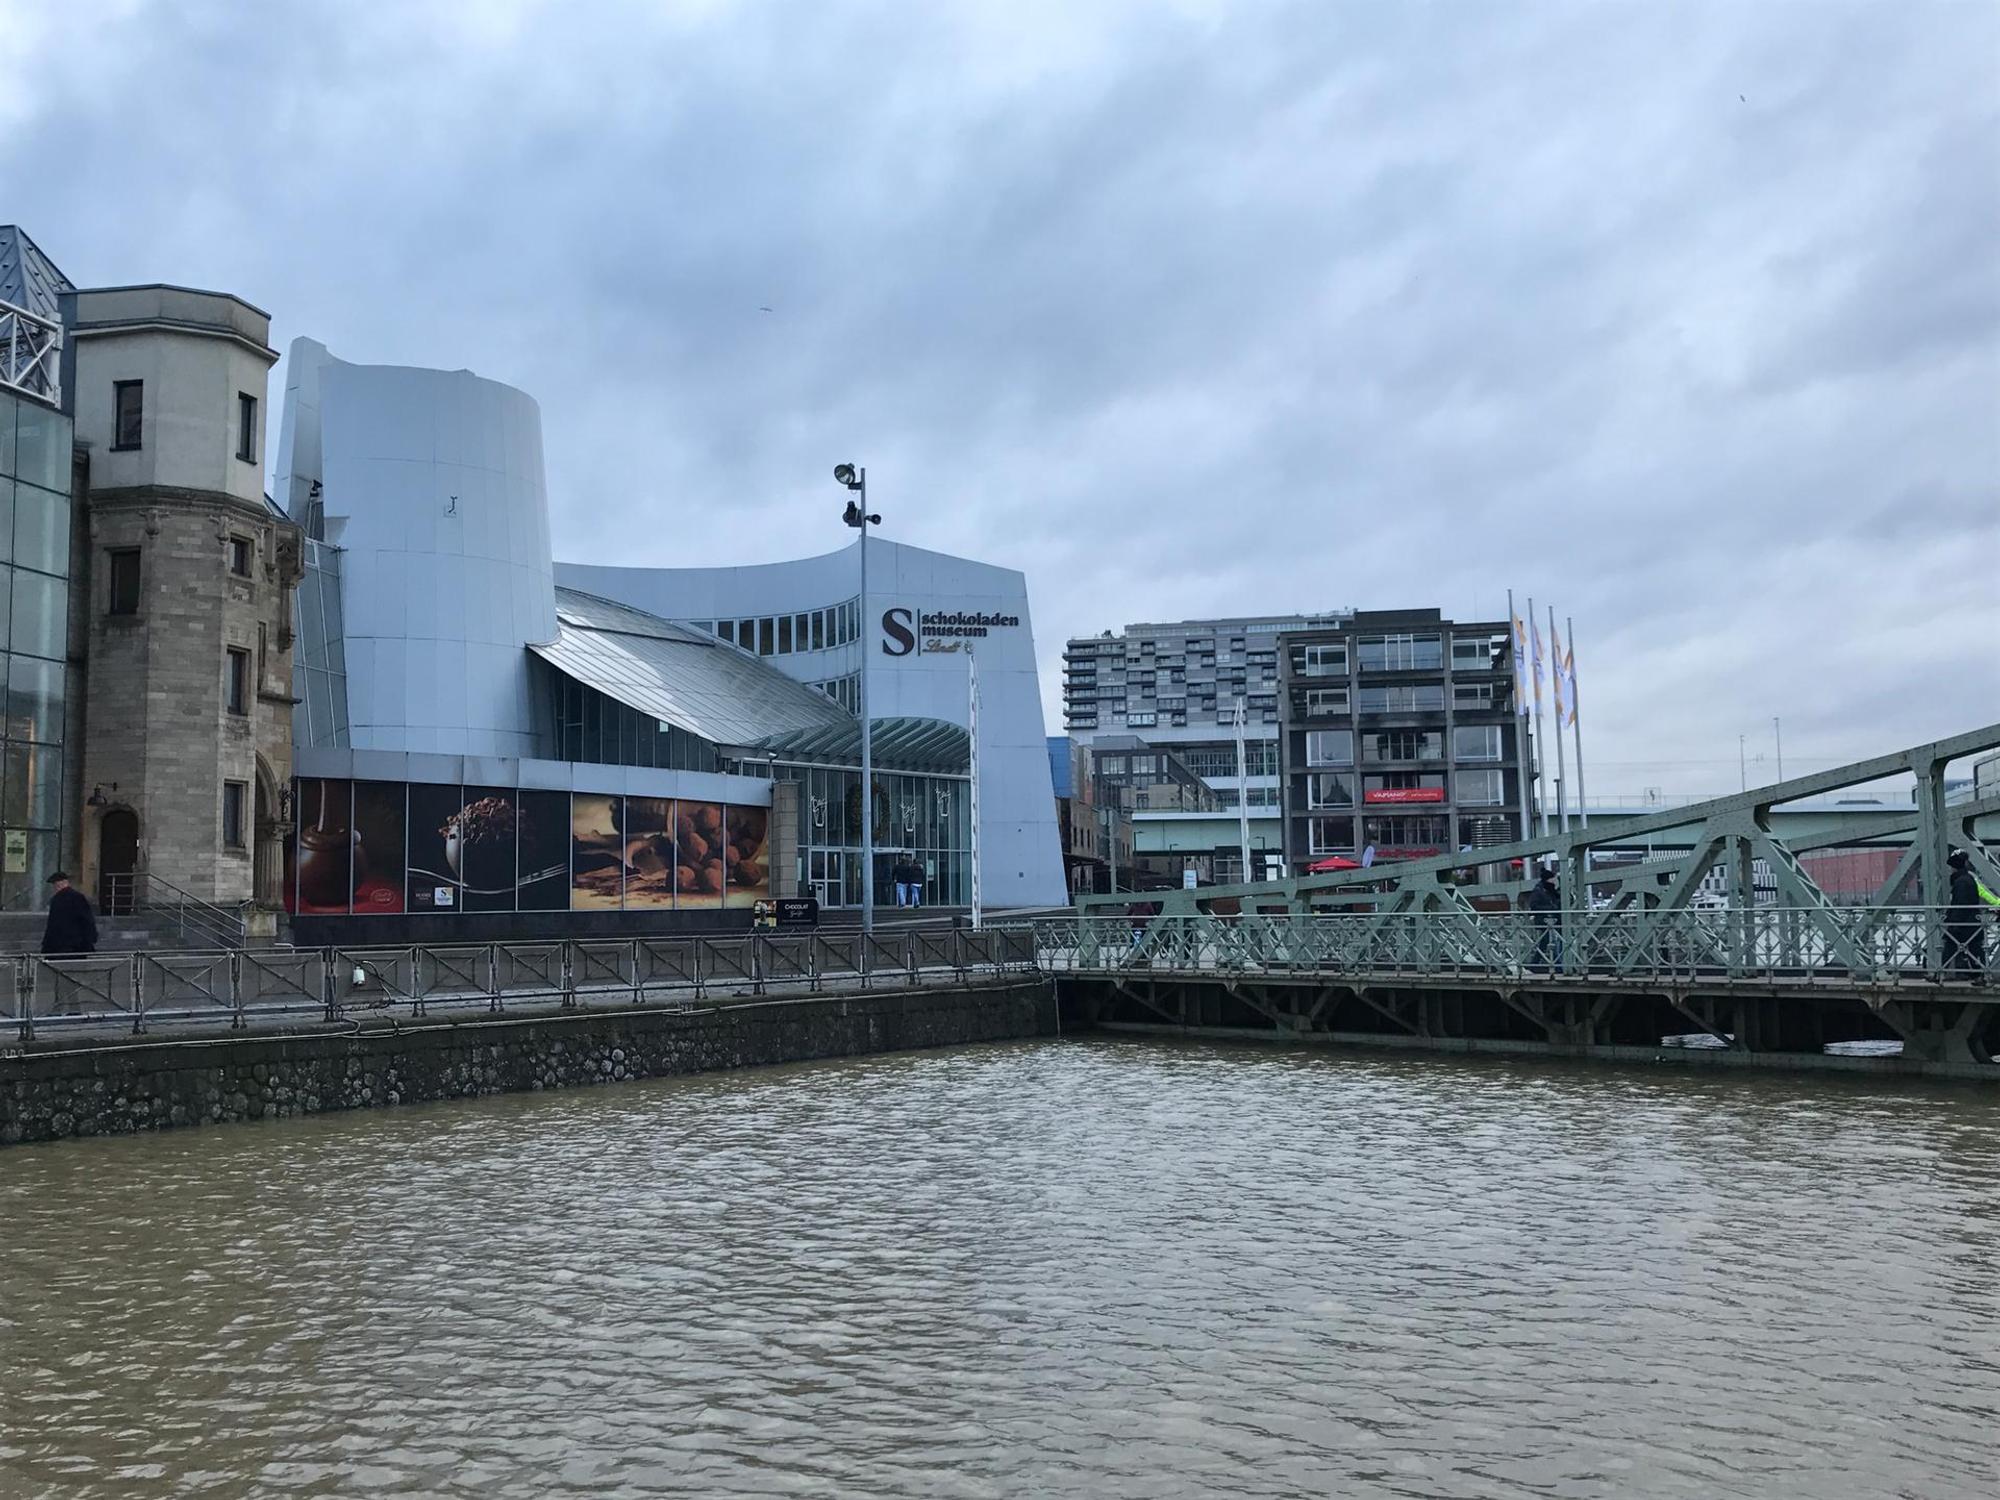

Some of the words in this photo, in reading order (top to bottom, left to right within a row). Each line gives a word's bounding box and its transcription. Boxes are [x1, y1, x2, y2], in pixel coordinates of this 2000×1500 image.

[921, 611, 1019, 626] schokoladen
[881, 608, 915, 656] S
[921, 625, 988, 637] museum
